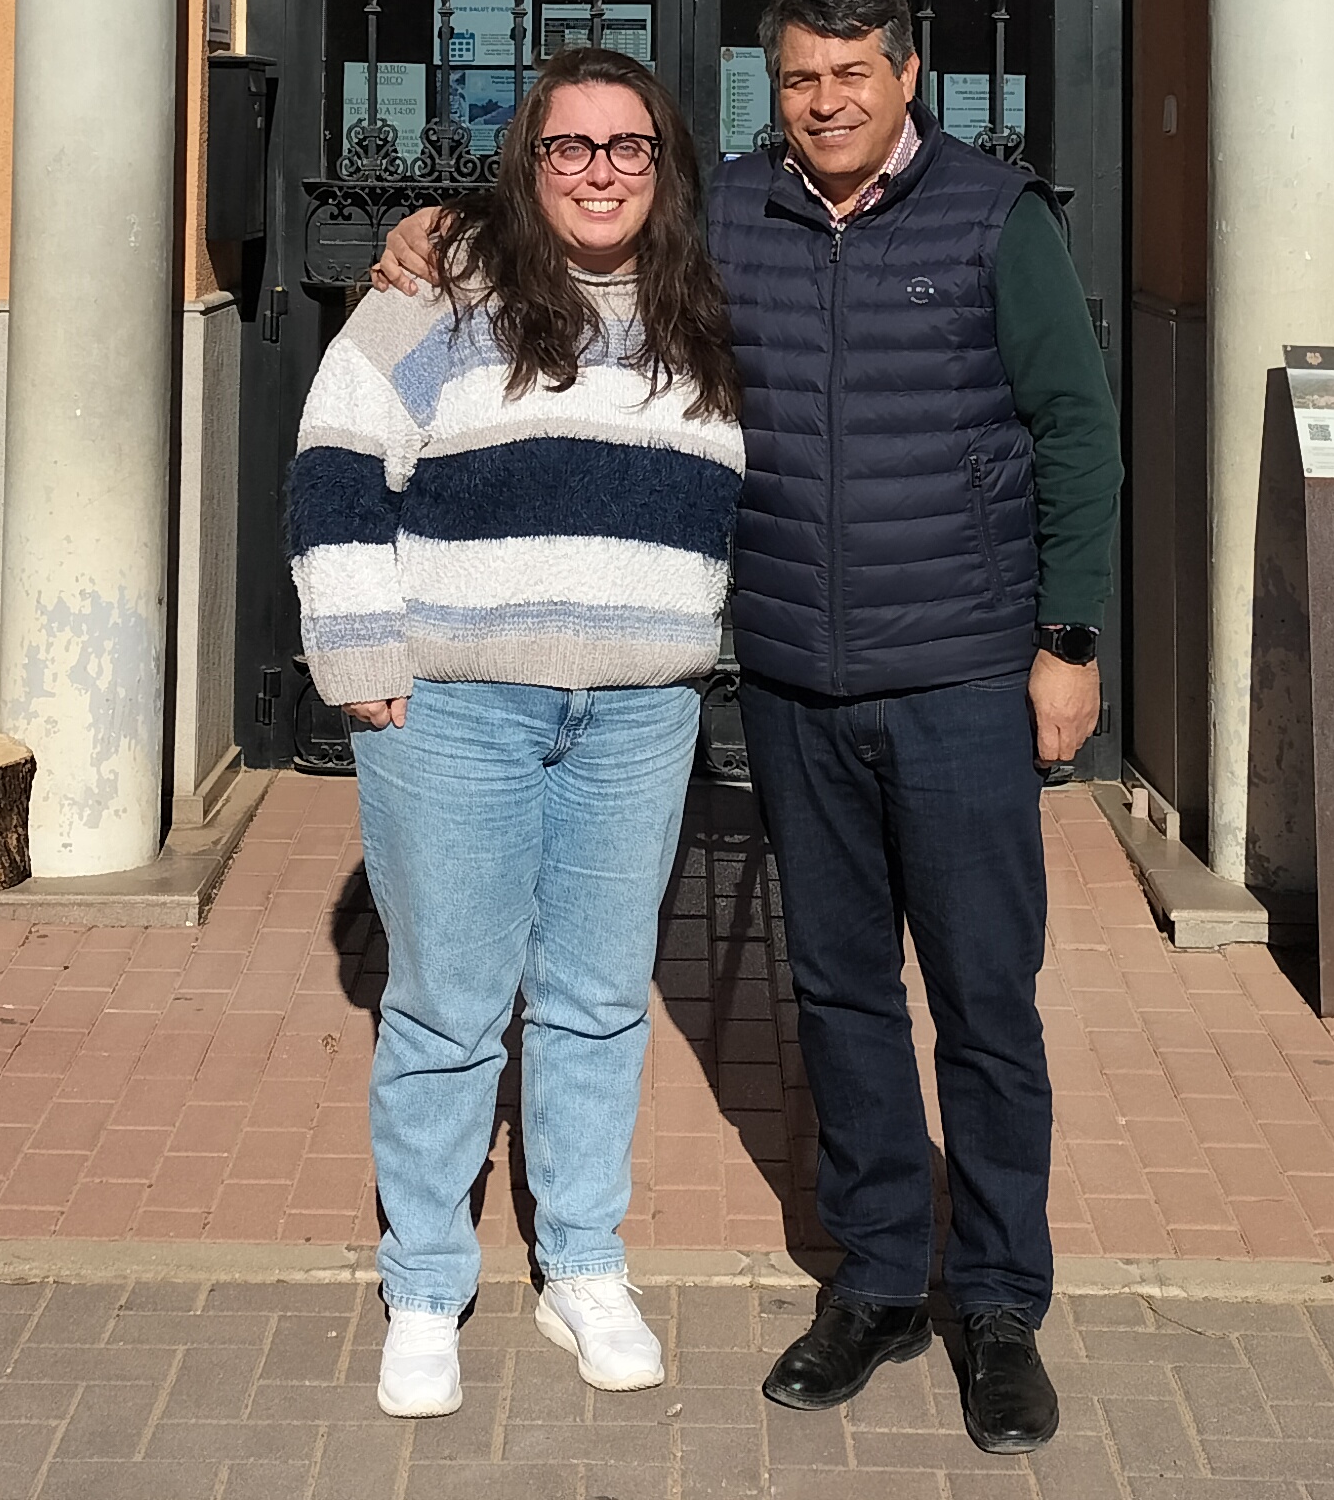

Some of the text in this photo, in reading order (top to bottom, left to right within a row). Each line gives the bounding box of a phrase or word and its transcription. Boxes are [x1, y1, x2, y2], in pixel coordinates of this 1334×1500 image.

[361, 64, 407, 75] HRARIO
[364, 76, 403, 86] DICO
[349, 106, 363, 115] DE
[393, 107, 416, 115] 14:00
